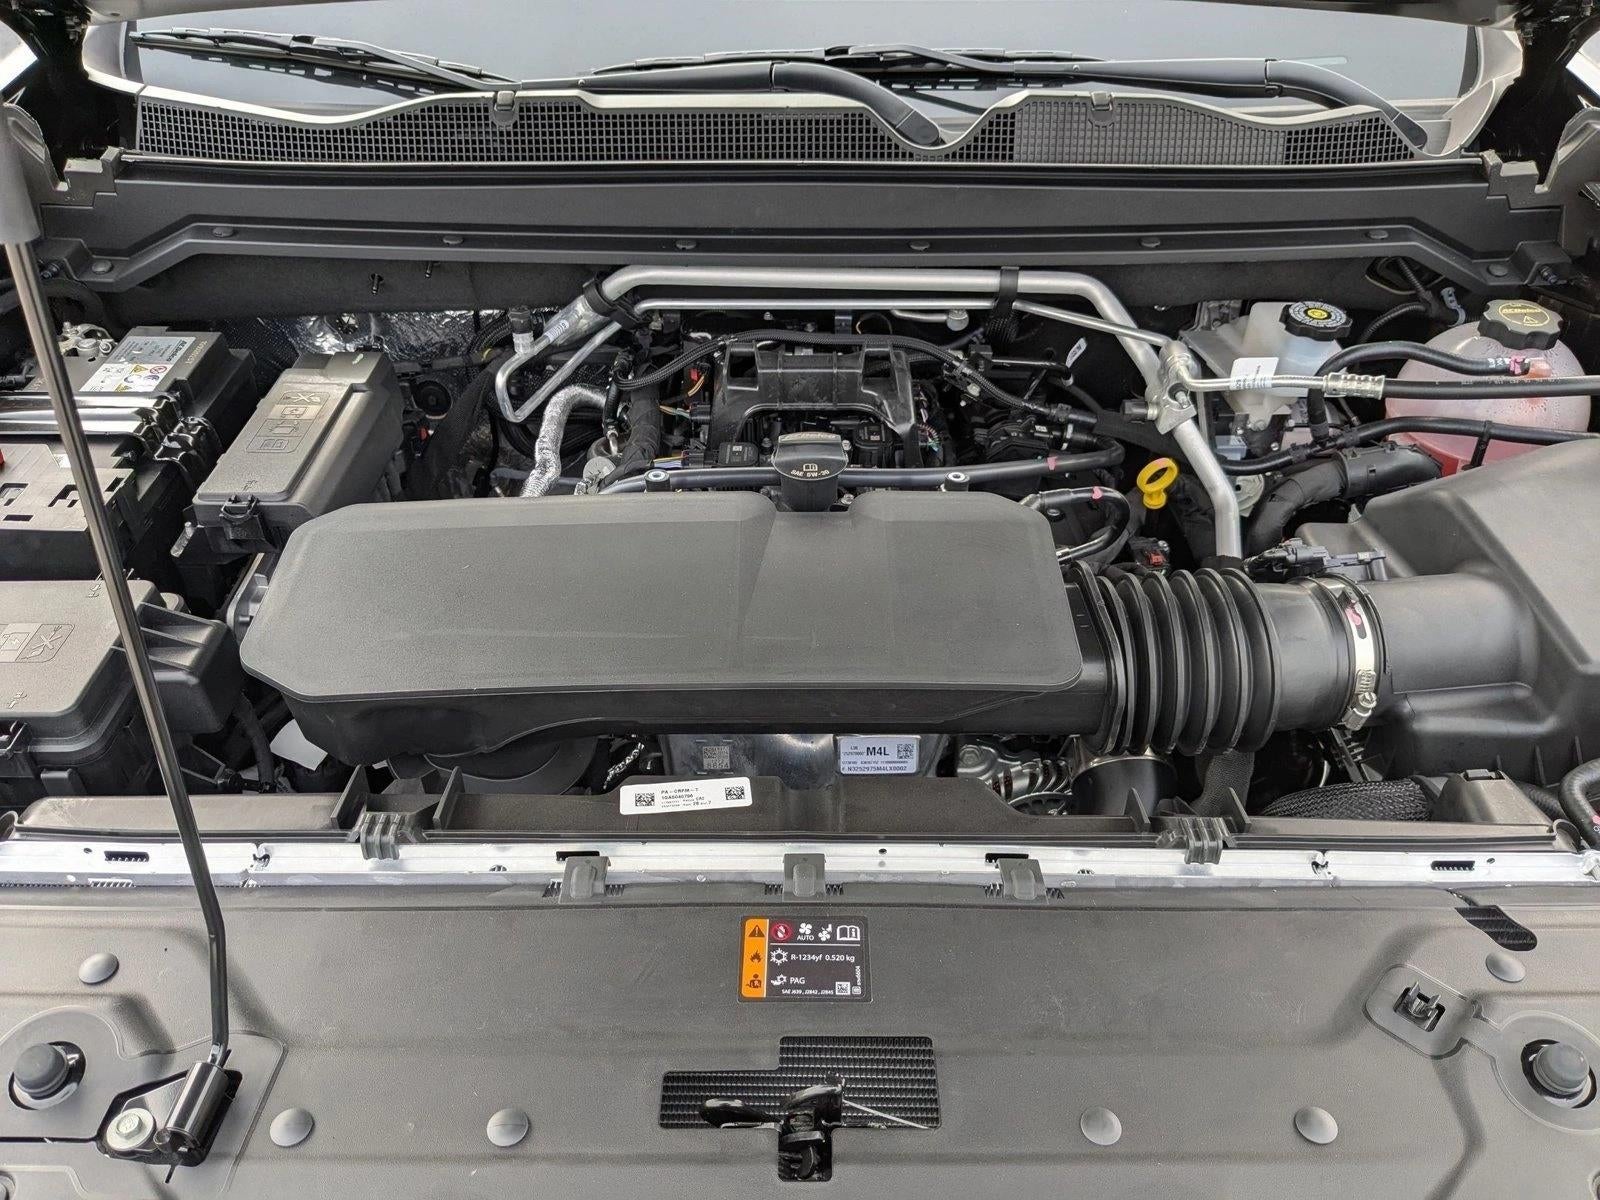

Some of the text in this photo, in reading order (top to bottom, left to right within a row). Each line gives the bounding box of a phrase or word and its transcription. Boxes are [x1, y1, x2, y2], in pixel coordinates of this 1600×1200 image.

[791, 469, 830, 478] SAE 5W-30
[866, 746, 890, 756] M4L
[790, 954, 823, 962] R-1234yf
[845, 954, 856, 963] kg
[789, 976, 806, 985] PAG
